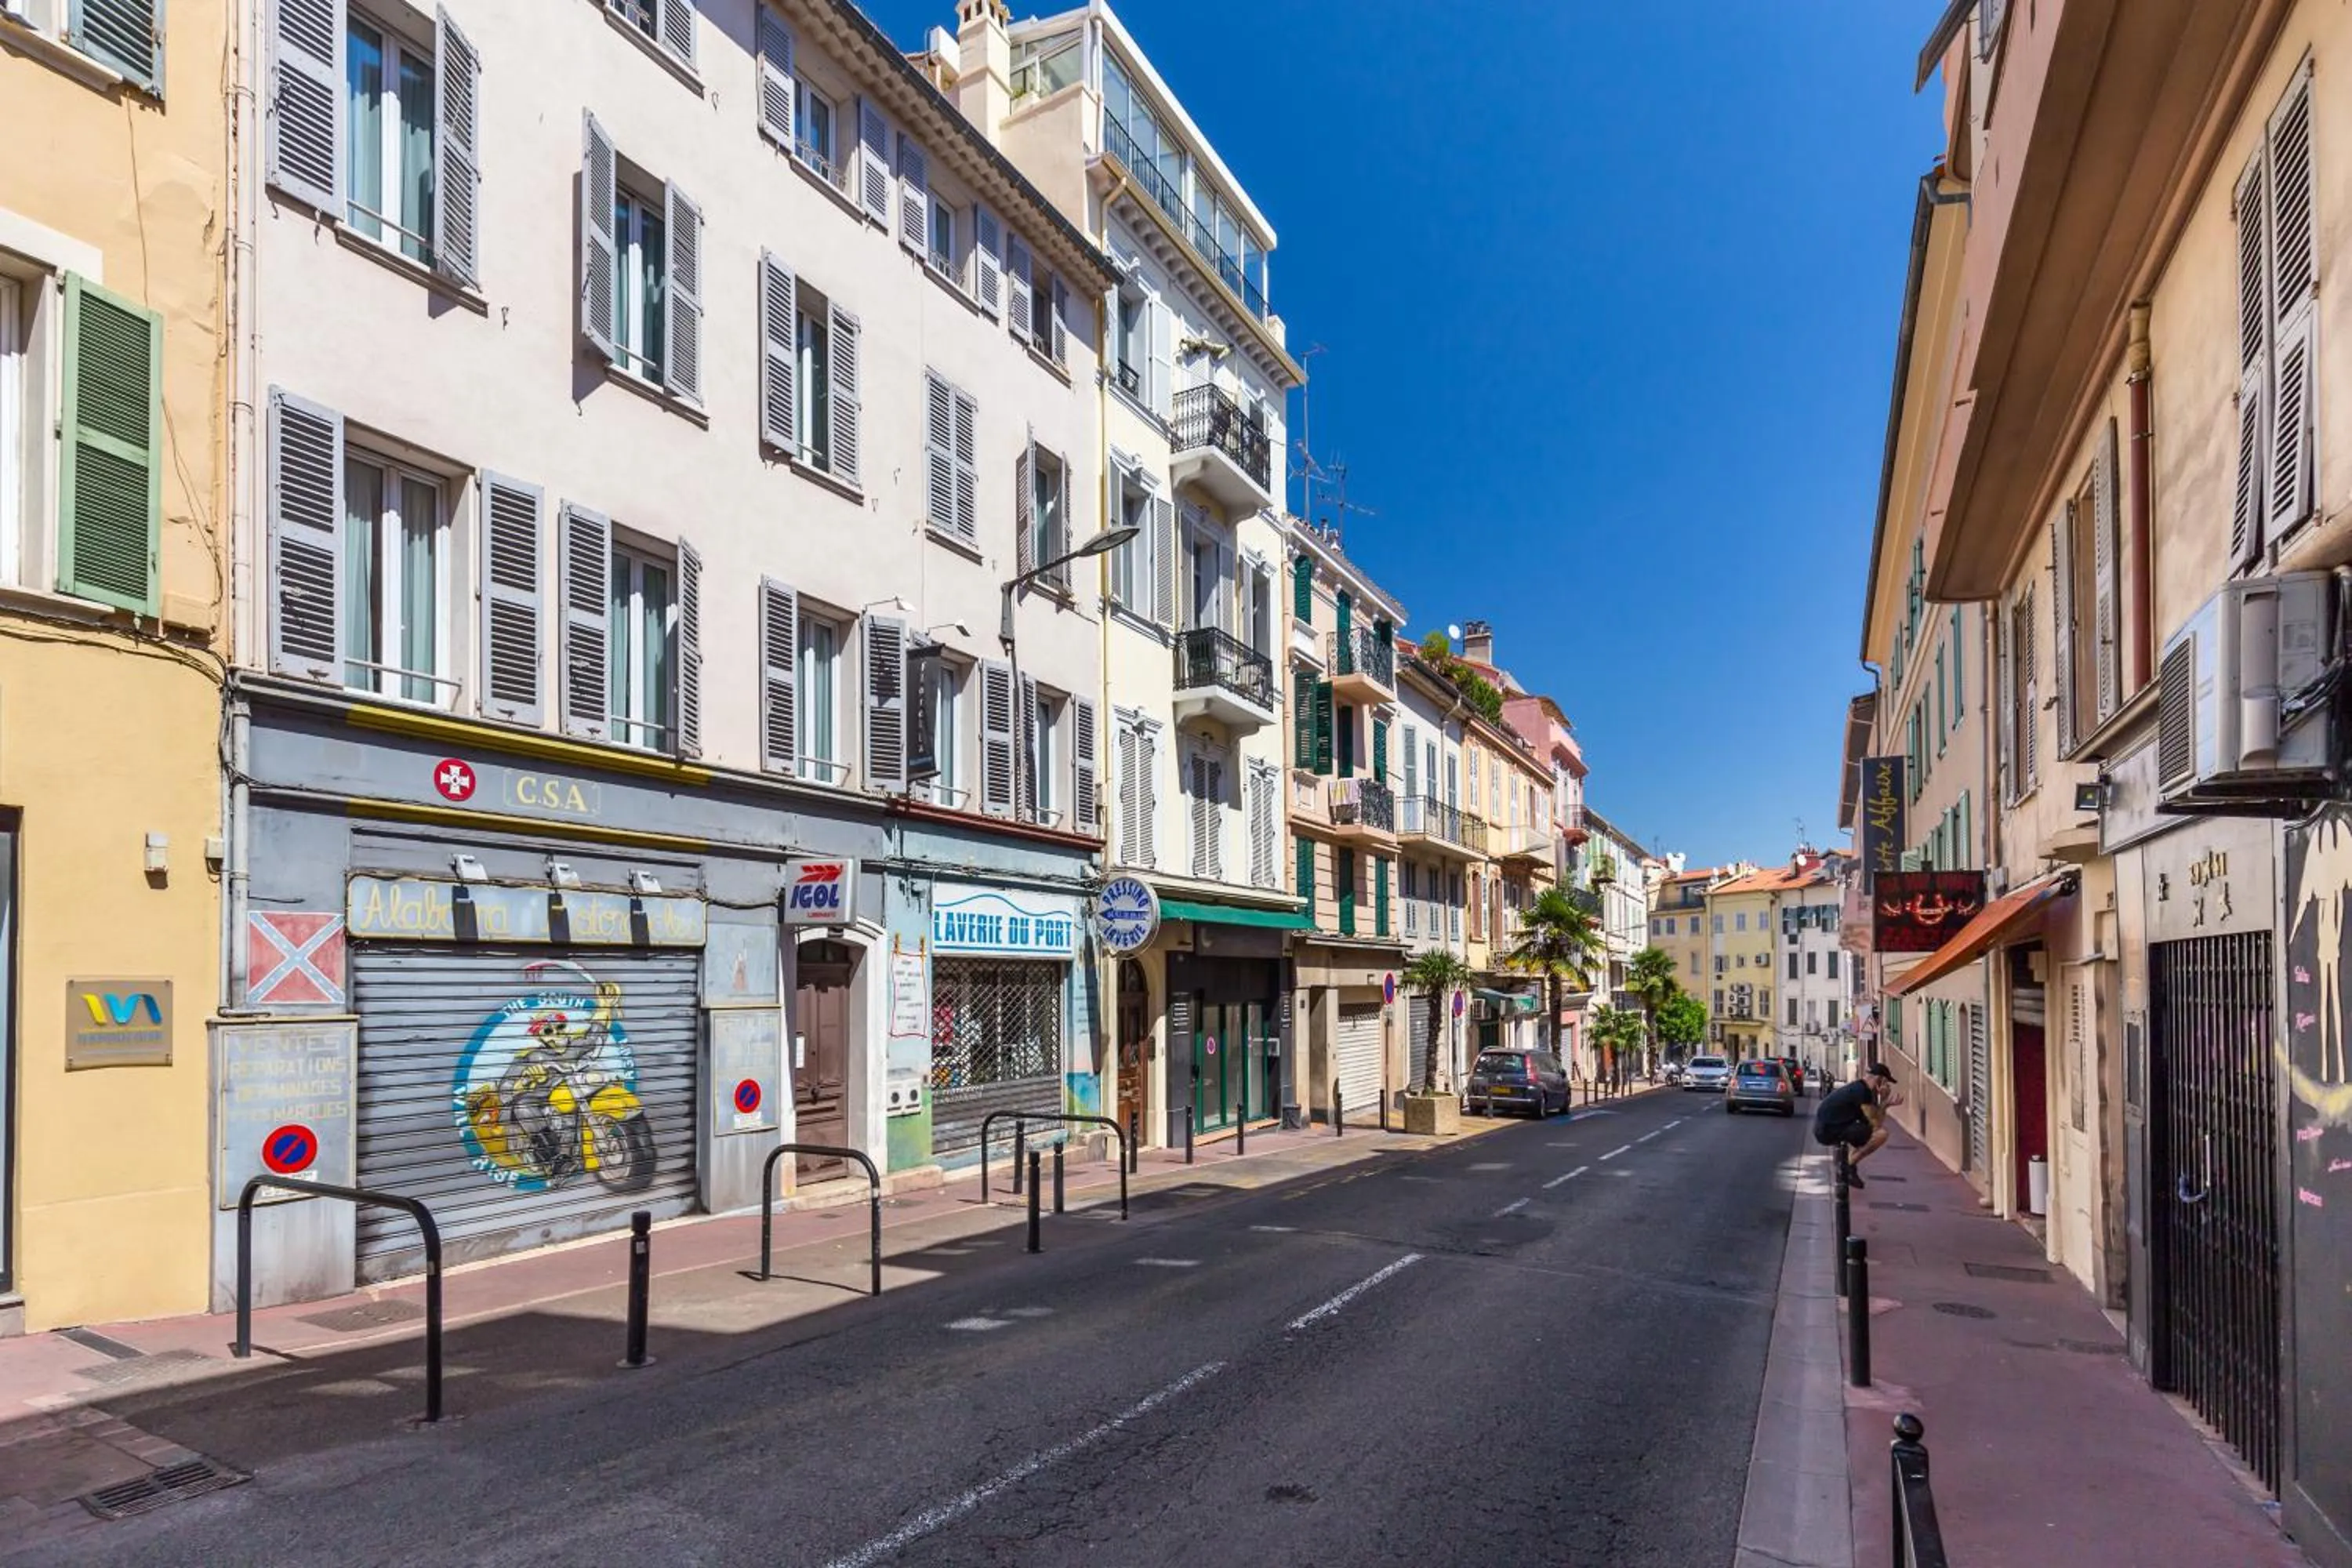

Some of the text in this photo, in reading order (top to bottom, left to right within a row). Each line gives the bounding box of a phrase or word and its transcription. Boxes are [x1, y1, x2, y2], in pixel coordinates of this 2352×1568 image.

[789, 884, 840, 909] IGOL
[934, 910, 1072, 948] LAVERIE DU PORT
[1104, 924, 1145, 947] LAVERIE
[236, 1033, 340, 1052] VENTES
